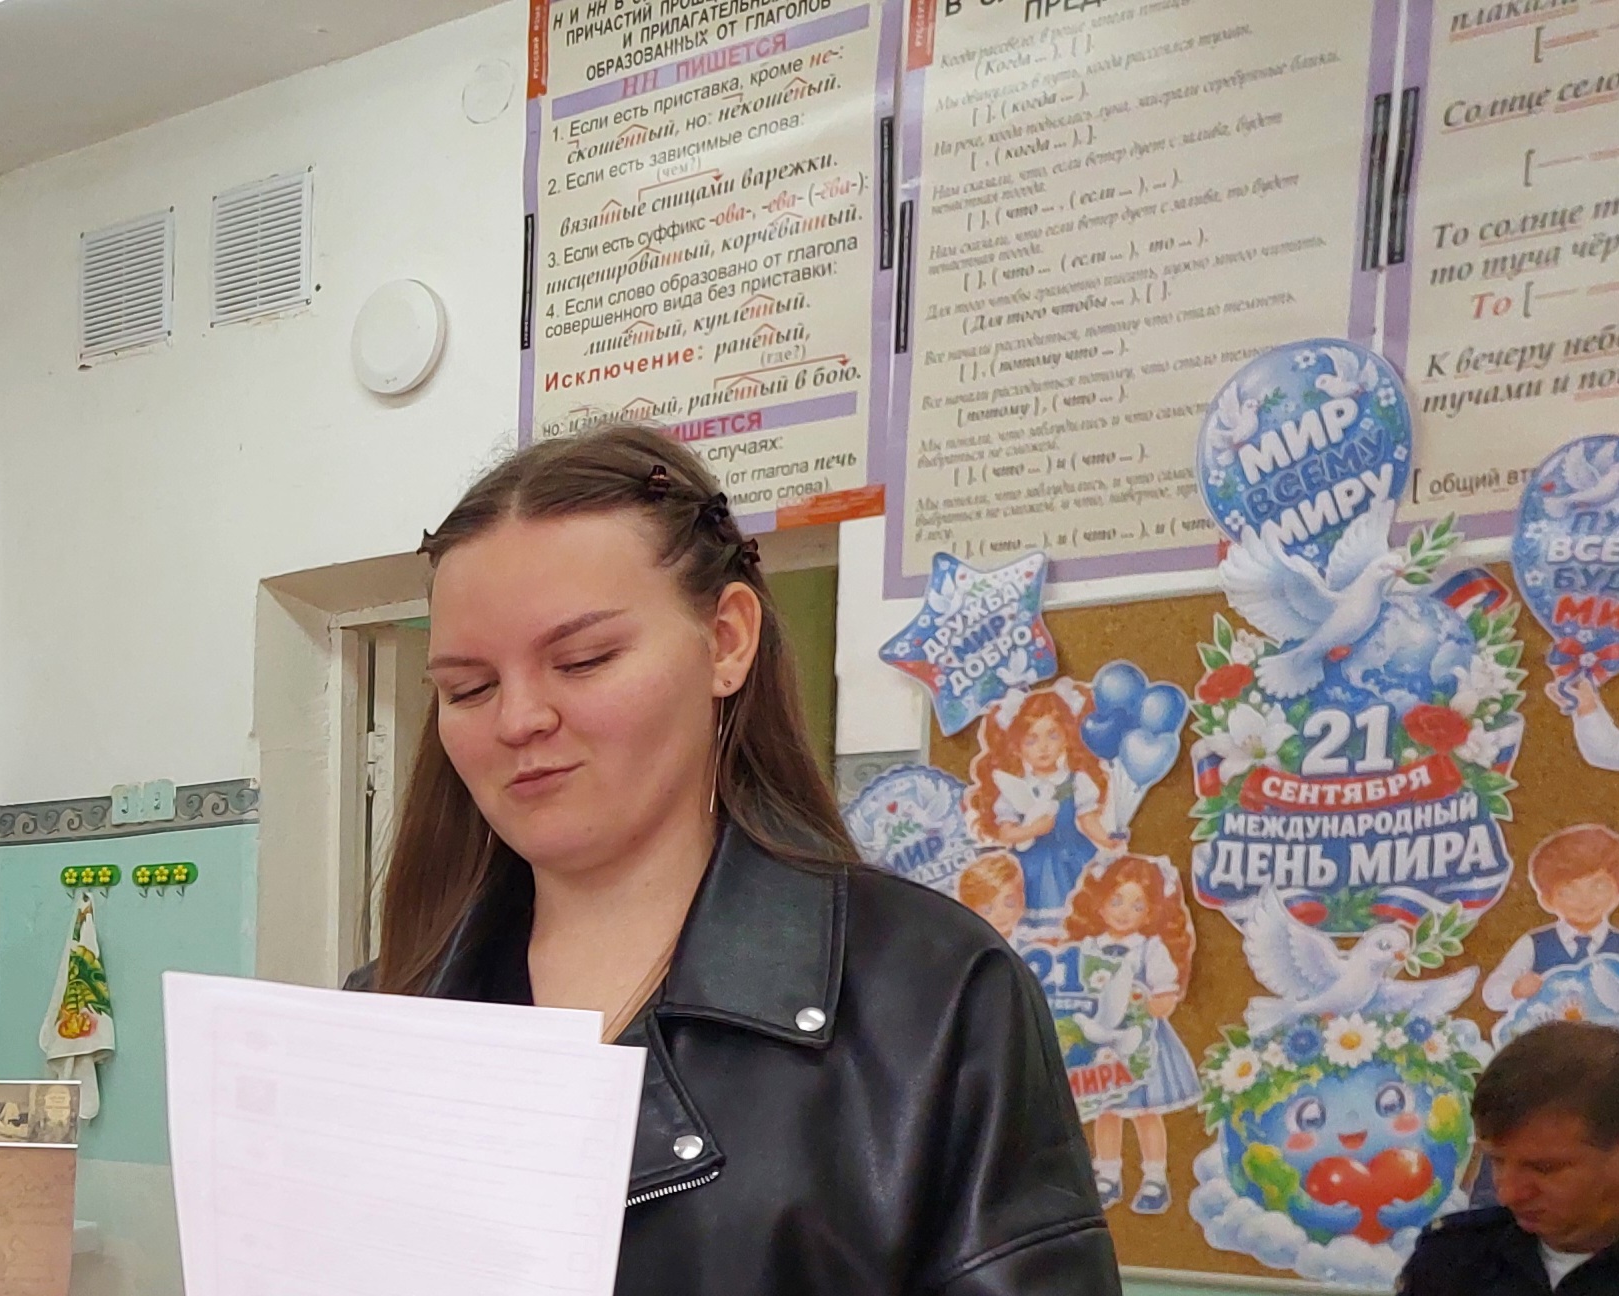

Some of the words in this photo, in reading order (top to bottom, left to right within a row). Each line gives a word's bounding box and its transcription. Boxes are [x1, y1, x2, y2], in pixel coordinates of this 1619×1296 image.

[566, 2, 652, 47] ПРИЧАСТИЙ
[586, 29, 709, 81] ОБРАЗОВАННЫХ
[717, 21, 736, 40] ОТ
[745, 0, 831, 32] ГЛАГОЛОВ
[623, 33, 632, 49] И
[622, 69, 658, 99] НН
[676, 33, 788, 82] ПИШЕТСЯ
[553, 125, 564, 142] 1.
[570, 117, 608, 138] Если
[613, 105, 648, 129] есть
[654, 76, 744, 116] приставка,
[750, 60, 803, 88] кроме
[548, 179, 561, 196] 2.
[566, 172, 604, 191] Если
[609, 159, 644, 178] есть
[649, 128, 742, 166] зависимые
[748, 113, 805, 140] слова:
[567, 122, 680, 165] скошенный,
[686, 114, 713, 132] но:
[561, 200, 646, 238] вязанные
[651, 179, 735, 213] спицами
[741, 152, 837, 187] варежки.
[548, 252, 561, 268] 3.
[563, 245, 599, 265] Если
[602, 236, 634, 255] есть
[637, 215, 706, 247] суффикс
[1433, 222, 1469, 249] То
[546, 239, 715, 295] инсценированный,
[546, 304, 560, 319] 4.
[565, 296, 603, 317] Если
[608, 284, 655, 309] слово
[660, 258, 758, 297] образовано
[763, 253, 782, 269] от
[787, 235, 858, 263] глагола
[1430, 261, 1473, 286] то
[1482, 246, 1561, 281] туча
[545, 303, 658, 338] совершенного
[663, 294, 702, 314] вида
[708, 280, 736, 301] без
[741, 262, 837, 297] приставки:
[694, 293, 811, 336] купленный.
[1471, 292, 1512, 320] То
[545, 346, 703, 391] Исключение:
[714, 322, 810, 362] раненый,
[1426, 351, 1449, 377] К
[1456, 341, 1555, 372] вечеру
[687, 375, 788, 416] раненный
[794, 368, 806, 390] в
[813, 364, 861, 386] бою.
[1423, 379, 1542, 418] тучами
[1552, 372, 1570, 395] и
[1238, 398, 1358, 484] МИР
[1246, 428, 1391, 523] ВСЕМУ
[1429, 468, 1500, 495] общий
[1261, 464, 1394, 545] МИРУ
[921, 579, 1026, 664] ДРУЖБА
[950, 615, 1006, 659] МИР
[950, 625, 1031, 696] ДОБРО
[1301, 704, 1394, 776] 21
[1261, 765, 1432, 805] СЕНТЯБРЯ
[1224, 793, 1478, 841] МЕЖДУНАРОДНЫЙ
[1210, 842, 1337, 889] ДЕНЬ
[1349, 825, 1499, 884] МИРА
[1023, 946, 1084, 994] 21
